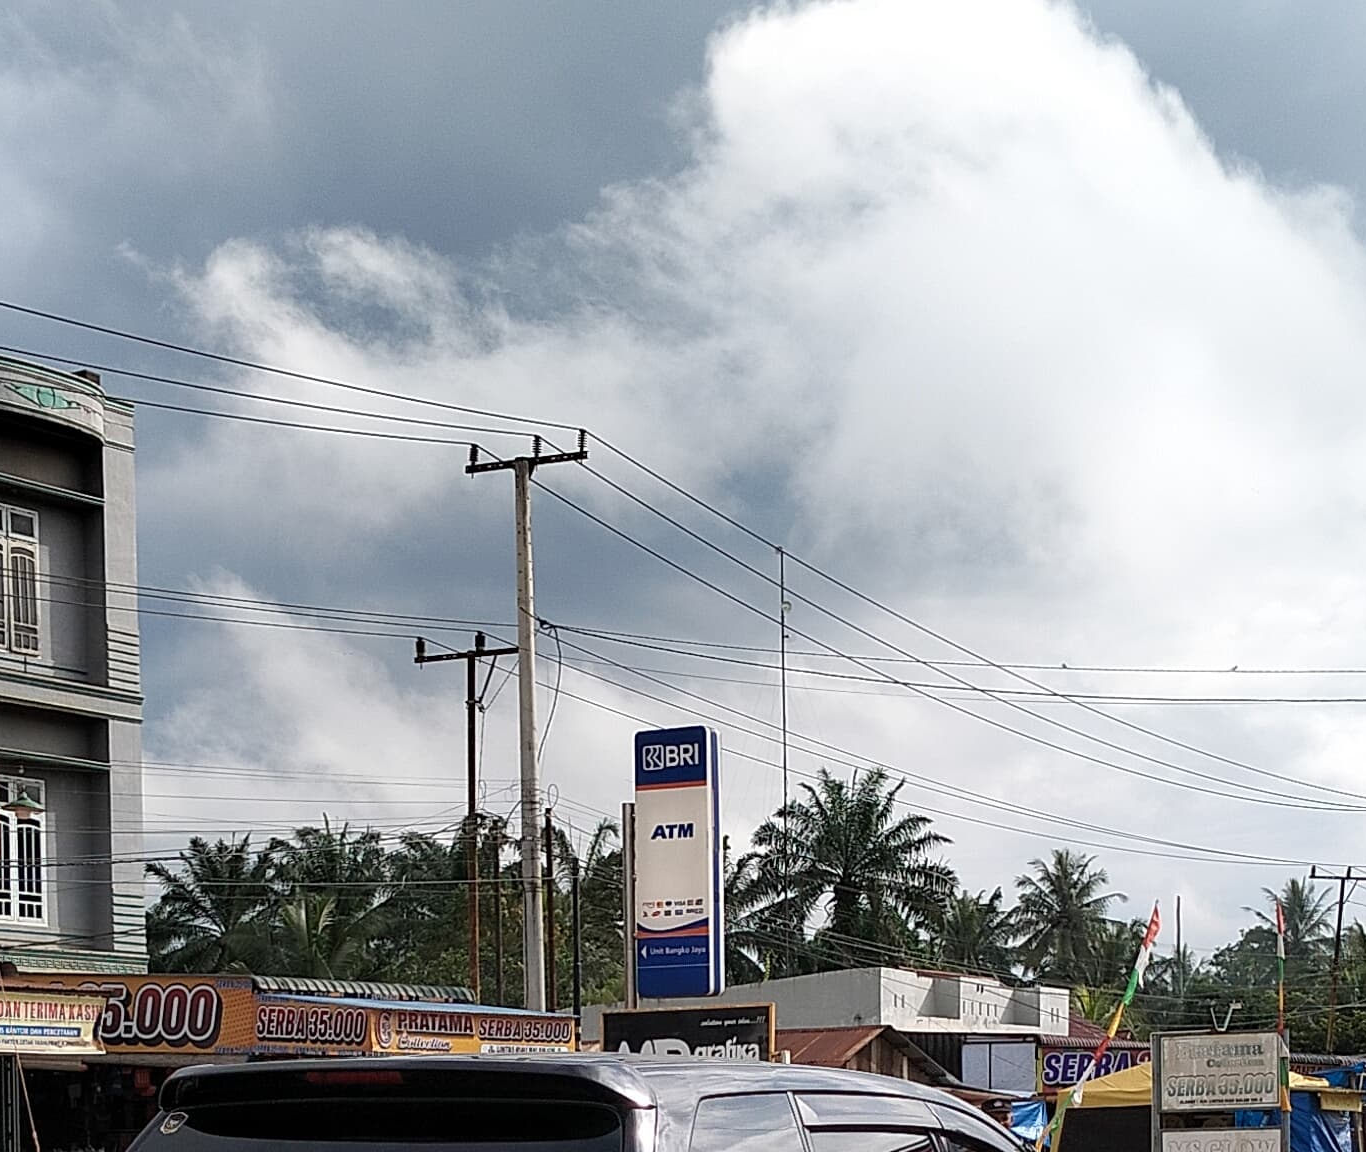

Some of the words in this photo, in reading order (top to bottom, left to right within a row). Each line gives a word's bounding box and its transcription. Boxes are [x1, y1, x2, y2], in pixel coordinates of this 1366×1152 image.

[665, 743, 699, 766] BRI
[650, 822, 694, 840] ATM
[23, 1001, 66, 1020] TERIMA
[99, 983, 220, 1042] 5.000
[256, 1005, 307, 1039] SERBA
[308, 1007, 367, 1042] 35.000
[397, 1012, 474, 1034] PRATAMA
[479, 1018, 523, 1040] SERBA
[1167, 1074, 1216, 1097] SERBA
